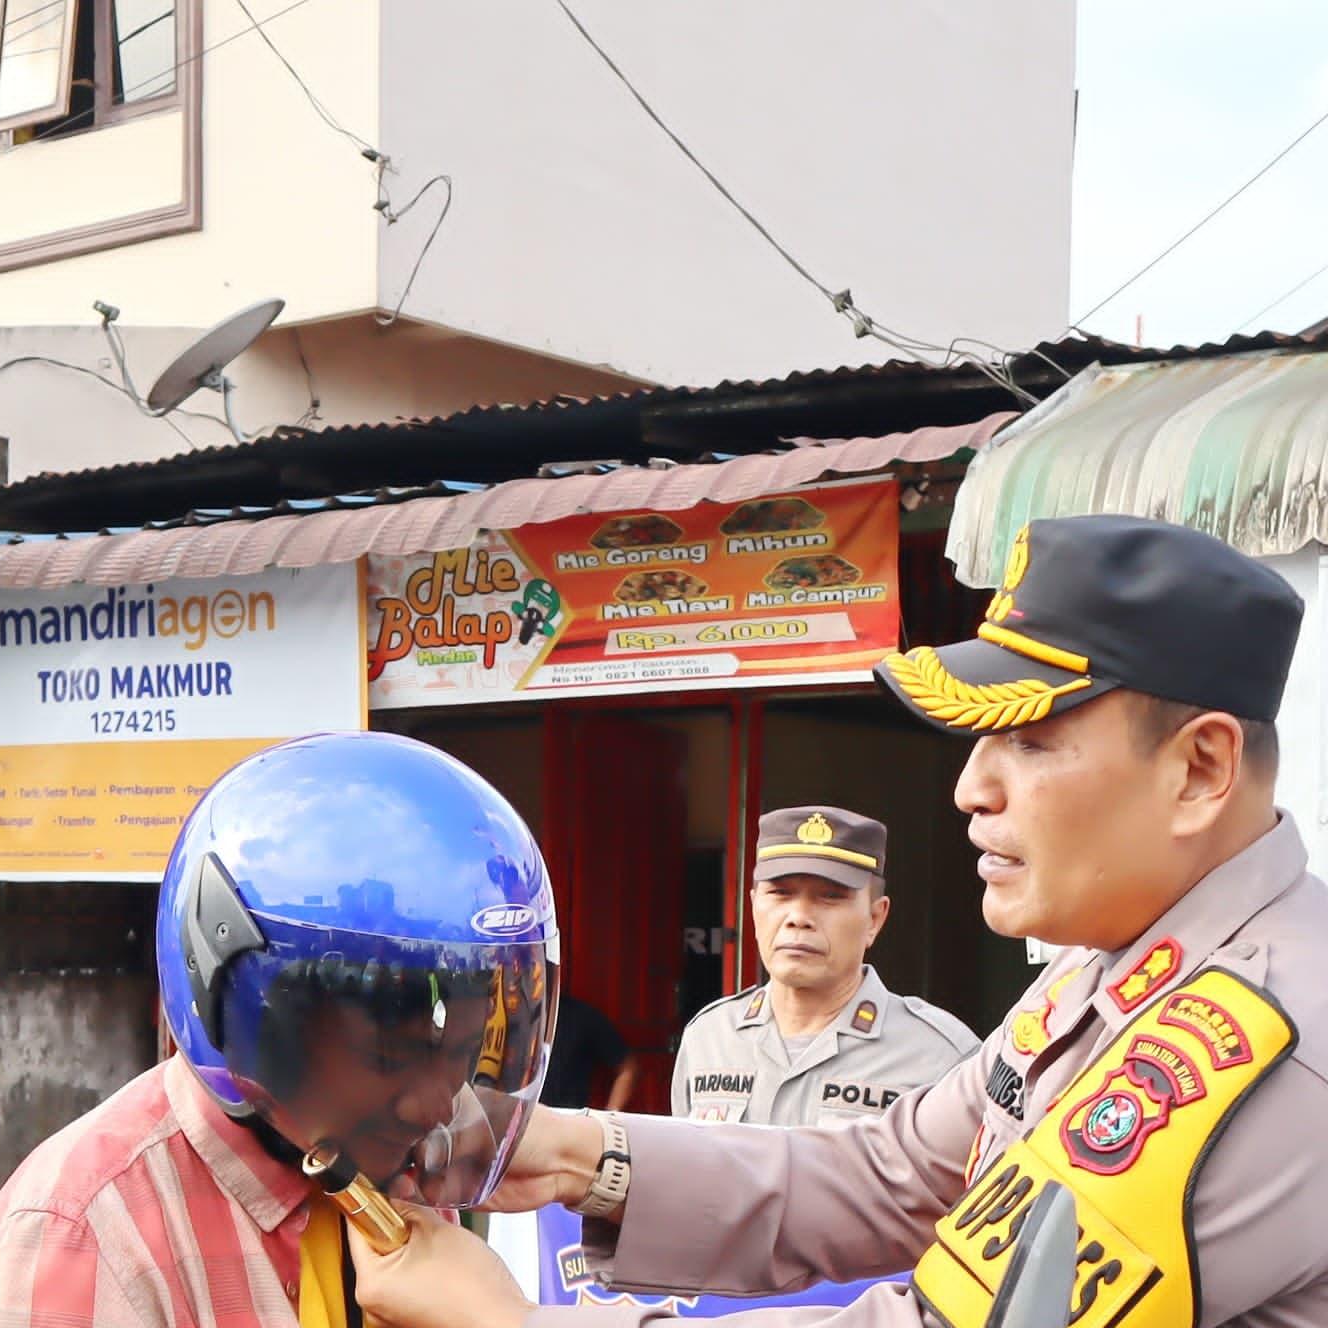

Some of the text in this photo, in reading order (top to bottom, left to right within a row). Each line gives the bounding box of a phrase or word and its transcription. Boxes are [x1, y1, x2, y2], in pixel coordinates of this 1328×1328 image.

[727, 533, 827, 554] Mihun
[556, 544, 709, 570] Mie Goreng
[747, 585, 885, 608] Mie Campur
[602, 603, 657, 620] Mie
[368, 594, 514, 683] Balap
[695, 619, 809, 644] 6.000
[416, 648, 478, 667] Medan
[38, 661, 233, 703] TOKO MAKMUR
[90, 709, 176, 735] 1274215
[108, 784, 176, 799] Pembayaran
[482, 910, 532, 929] ZIP
[694, 1073, 755, 1094] TARIGAN
[822, 1083, 901, 1110] POLR
